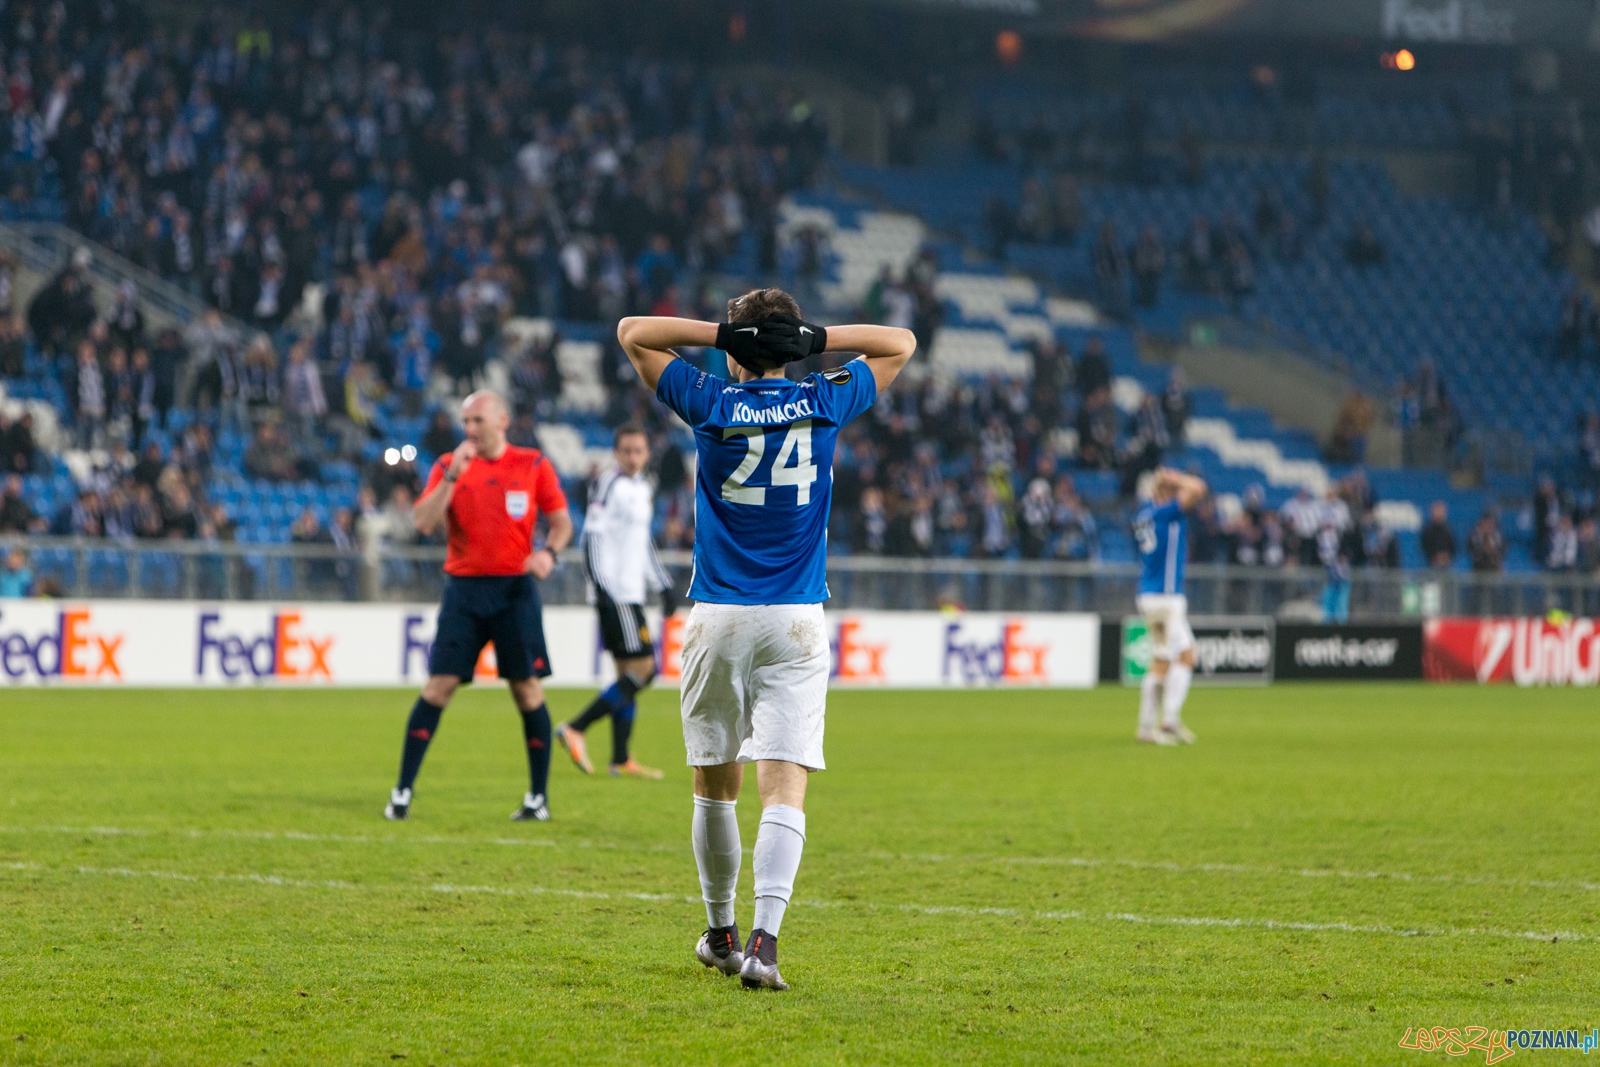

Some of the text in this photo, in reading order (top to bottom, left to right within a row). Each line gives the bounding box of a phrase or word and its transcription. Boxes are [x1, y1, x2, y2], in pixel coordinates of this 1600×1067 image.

[731, 398, 814, 424] KOWNACKI
[721, 418, 818, 506] 24
[0, 611, 123, 679] edEx
[195, 612, 333, 680] FedEx
[943, 620, 1049, 683] FedEx
